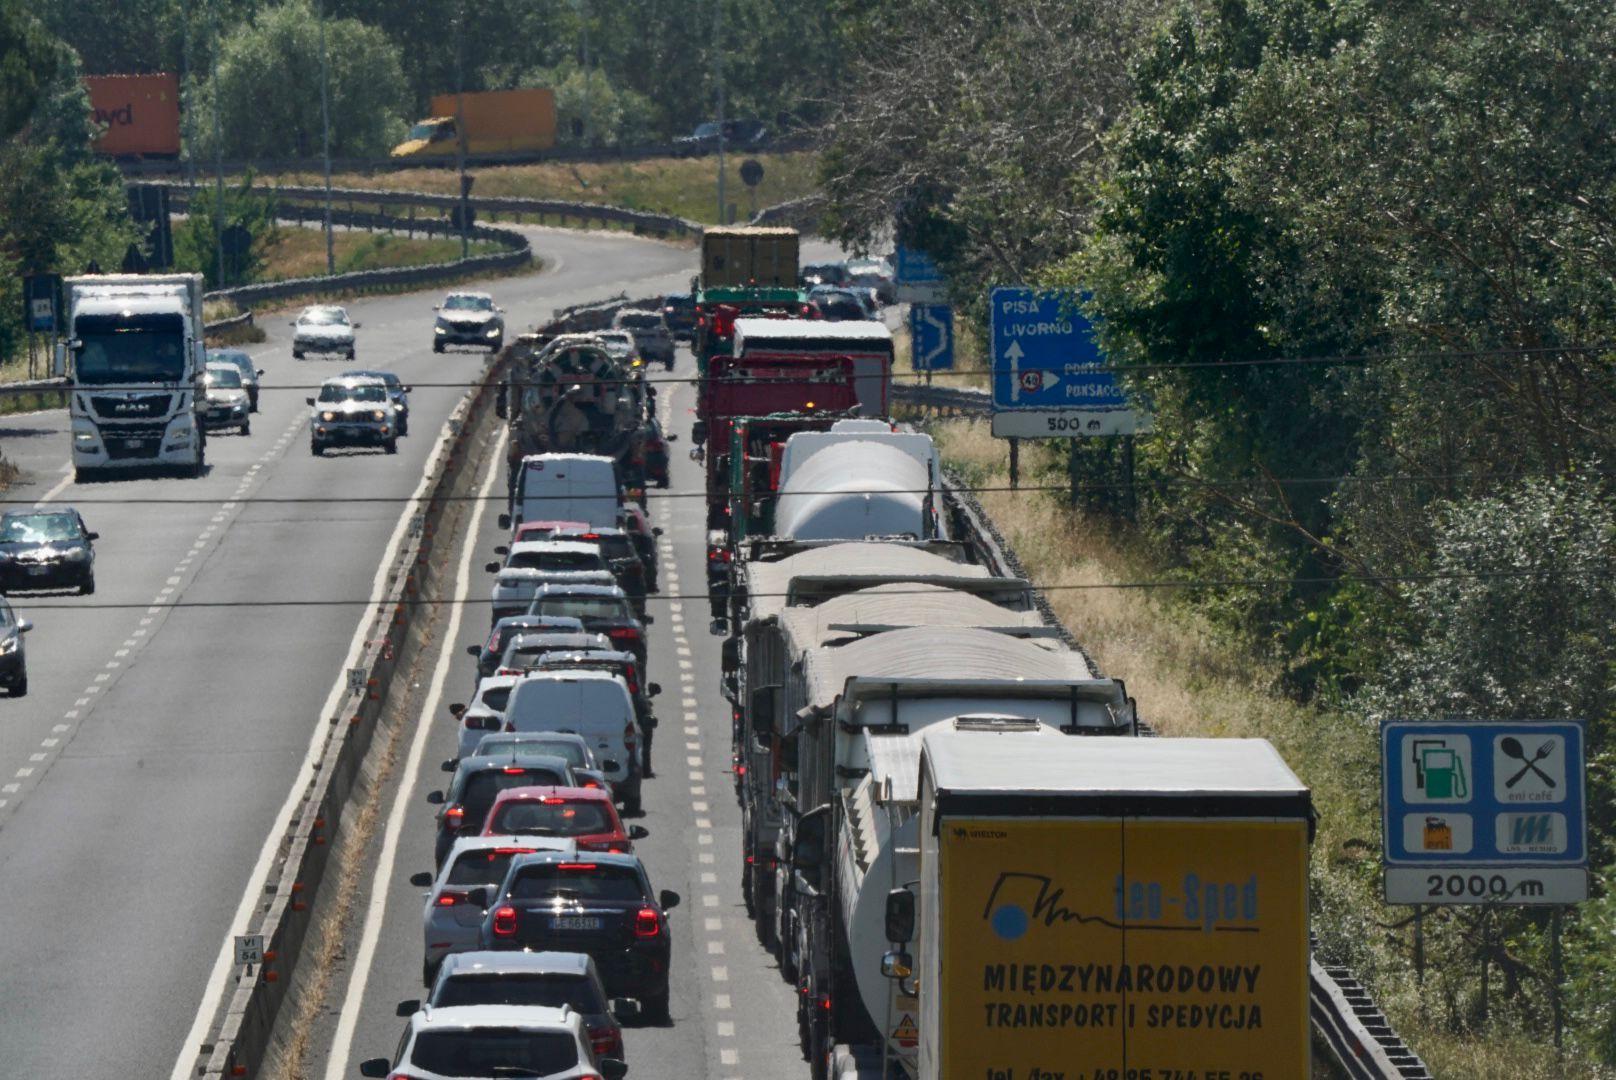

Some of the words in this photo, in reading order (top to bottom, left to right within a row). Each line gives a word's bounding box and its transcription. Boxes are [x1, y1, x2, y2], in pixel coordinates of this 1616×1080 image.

[1003, 300, 1039, 314] PISA
[1004, 321, 1073, 337] LIVORNO
[1047, 417, 1080, 431] 500
[1087, 419, 1101, 430] m
[1427, 874, 1507, 897] 2000
[1520, 879, 1544, 896] m
[983, 963, 1262, 996] MIĘDZYNARODOWY
[985, 1003, 1119, 1028] TRANSPORT
[1128, 1004, 1136, 1028] I
[1146, 1003, 1263, 1029] SPEDYCJA
